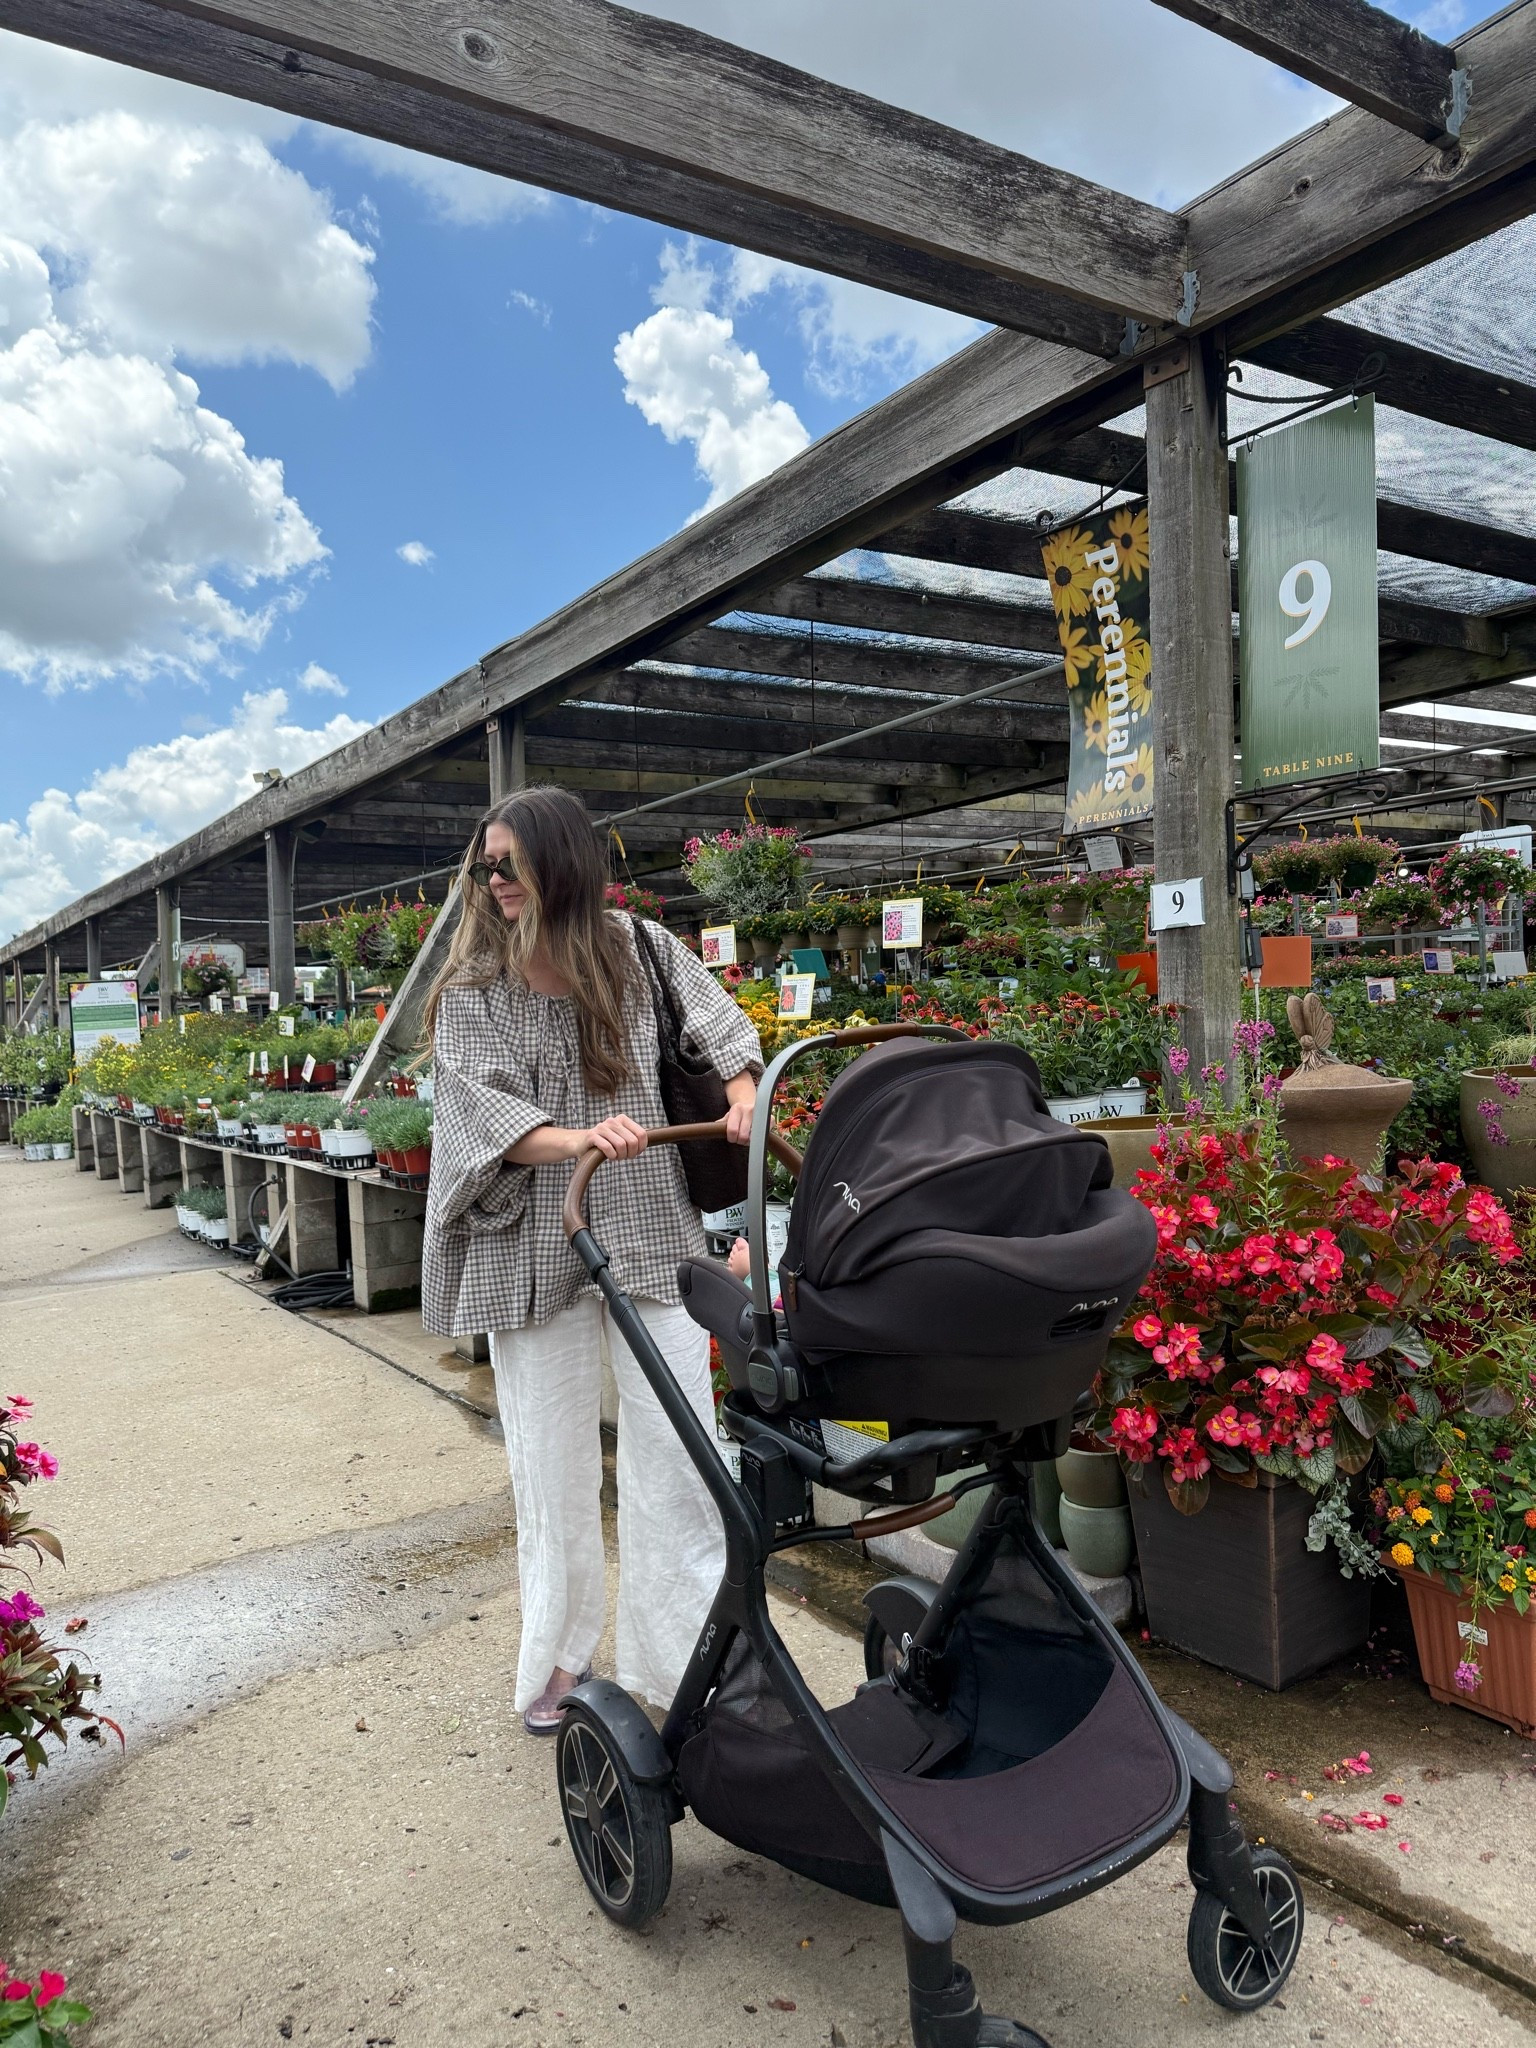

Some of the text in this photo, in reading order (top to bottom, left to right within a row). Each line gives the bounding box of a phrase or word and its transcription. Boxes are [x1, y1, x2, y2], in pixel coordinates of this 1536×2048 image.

[1279, 560, 1331, 649] 9
[1085, 542, 1138, 793] Perennials
[1263, 752, 1354, 777] TABLE NINE
[1079, 804, 1149, 824] PERENNIALS
[1171, 890, 1184, 914] 9
[725, 1206, 744, 1218] PW
[1069, 1296, 1119, 1312] nuna
[731, 1455, 741, 1466] P
